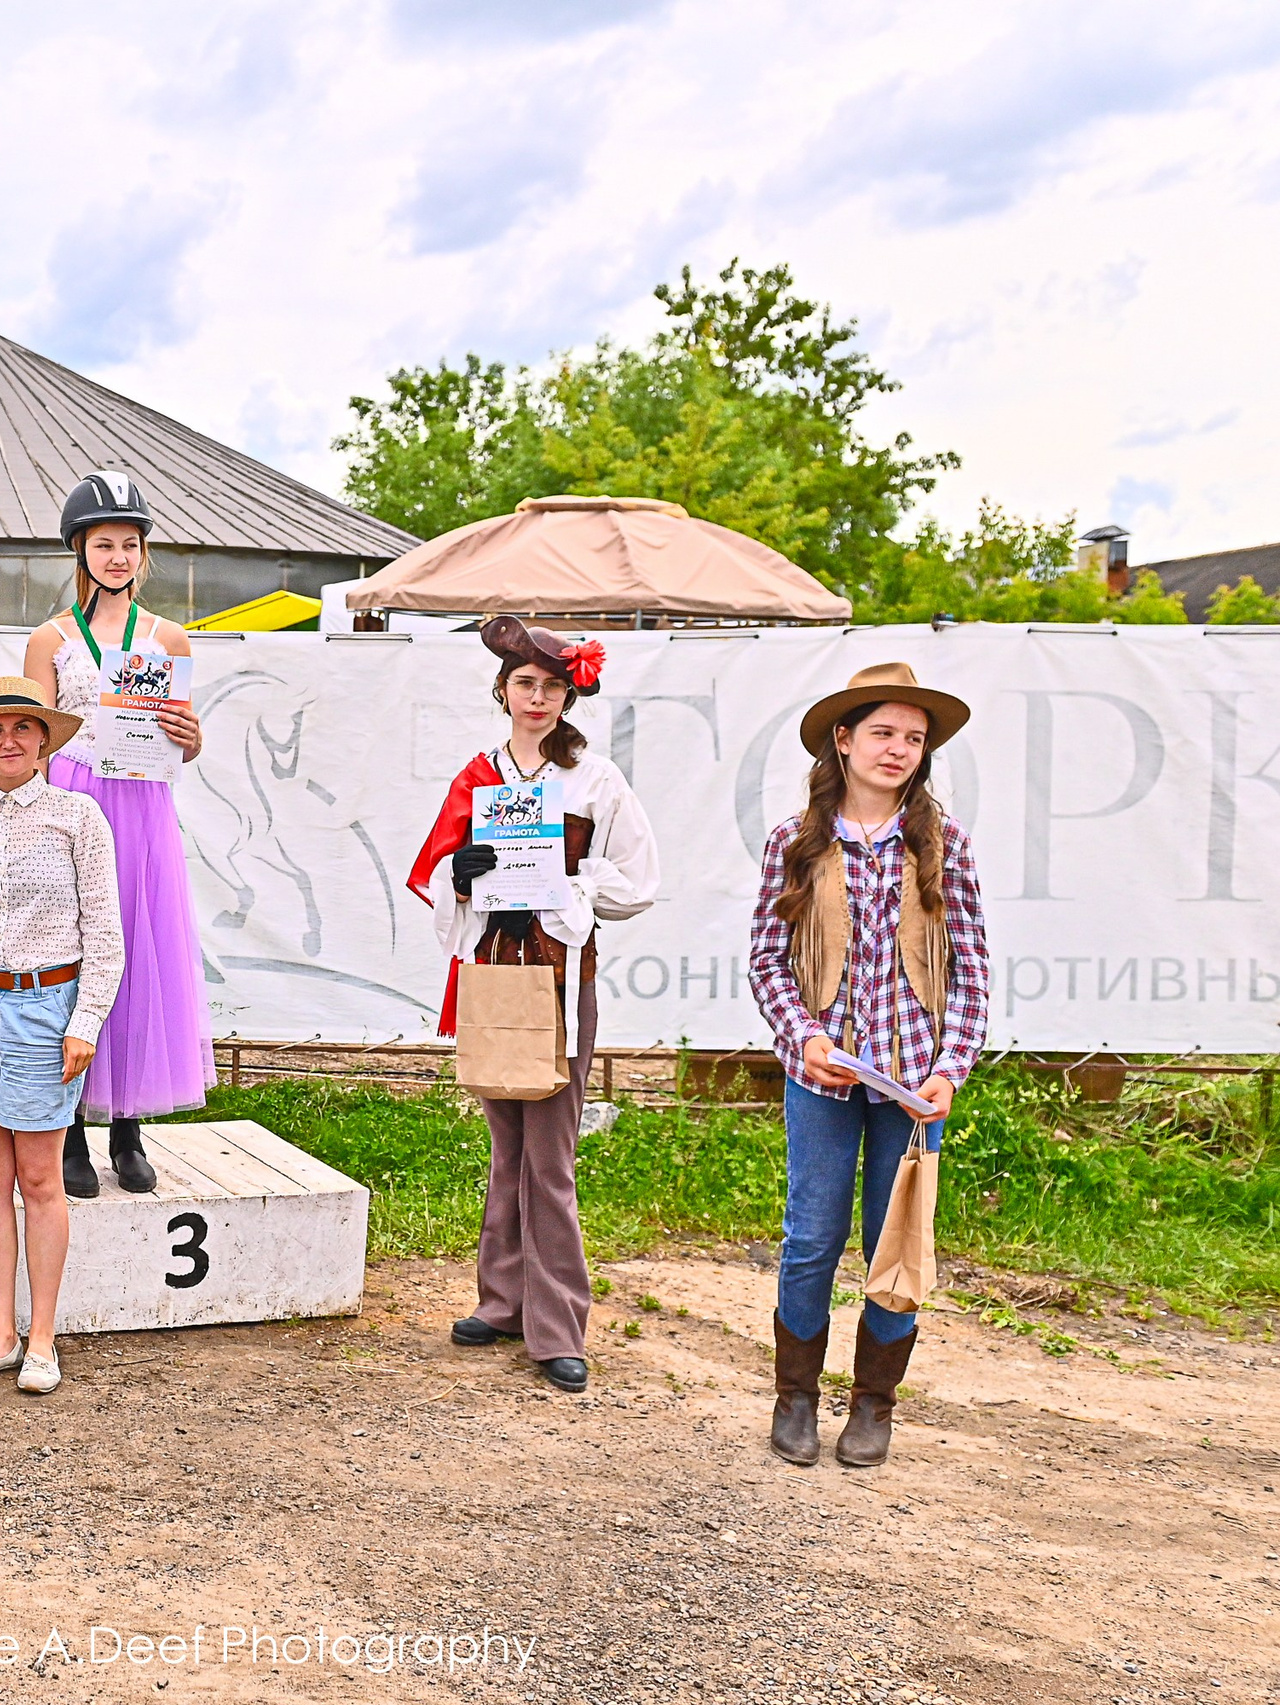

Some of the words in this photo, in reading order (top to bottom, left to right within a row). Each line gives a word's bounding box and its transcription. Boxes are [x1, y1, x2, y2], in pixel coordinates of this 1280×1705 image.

[121, 698, 166, 710] ГРАМОТА
[494, 828, 541, 837] ГРАМОТА
[164, 1212, 210, 1289] 3
